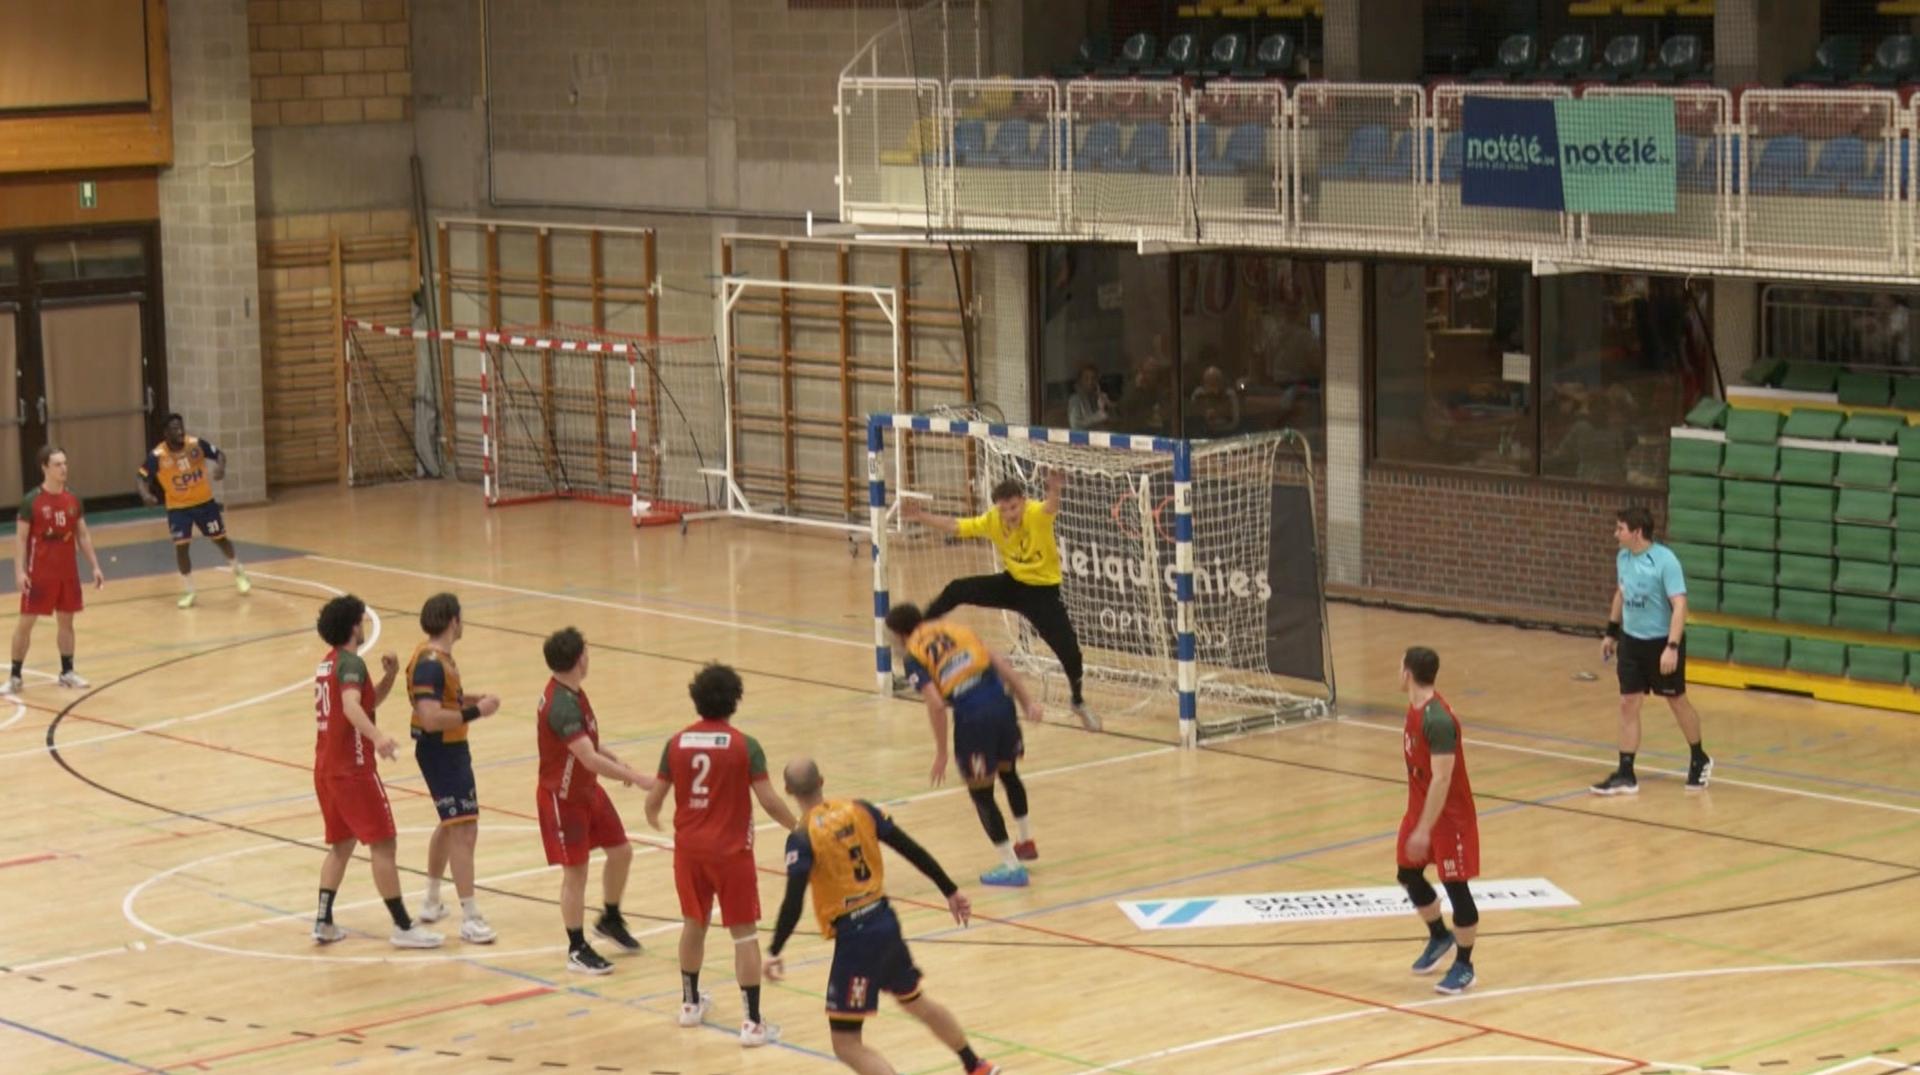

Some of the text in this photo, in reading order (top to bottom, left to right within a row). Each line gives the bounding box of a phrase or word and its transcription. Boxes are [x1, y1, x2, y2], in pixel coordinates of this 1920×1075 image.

[55, 511, 66, 527] 15
[315, 681, 331, 717] 20
[691, 753, 711, 795] 2
[848, 845, 872, 882] 3
[1246, 893, 1364, 907] GROUP
